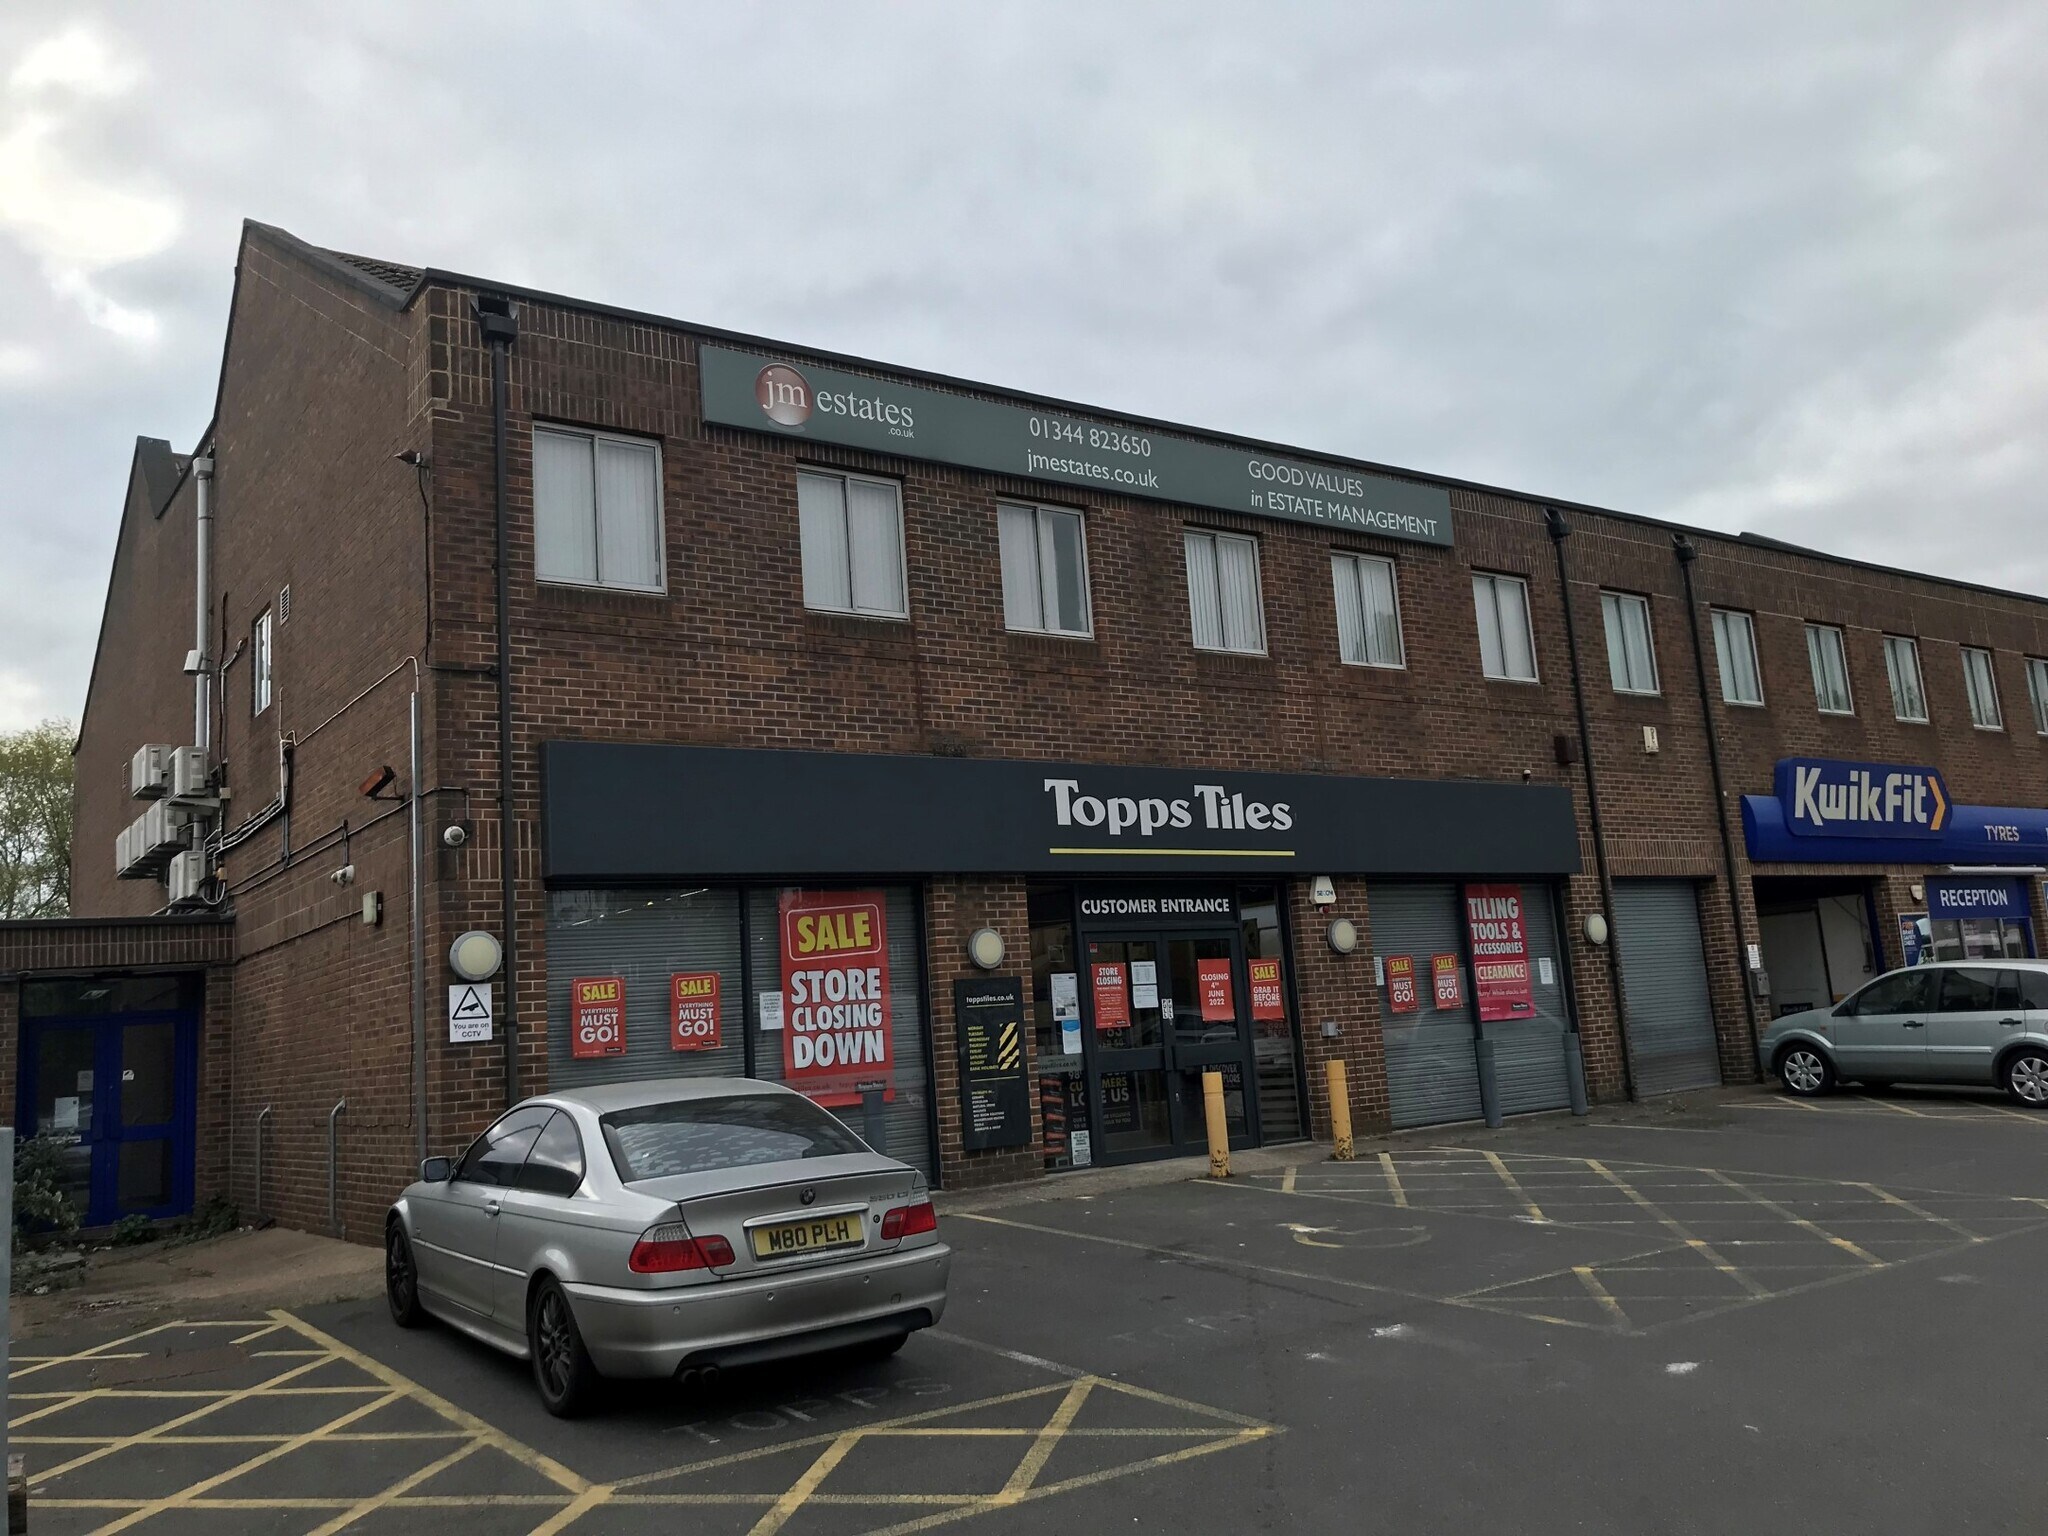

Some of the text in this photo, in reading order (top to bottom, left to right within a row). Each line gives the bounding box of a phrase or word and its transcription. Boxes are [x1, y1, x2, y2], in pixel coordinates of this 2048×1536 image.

[762, 371, 914, 428] jm estates
[888, 427, 914, 438] .co.uk
[1029, 416, 1151, 457] 01344 823650
[1027, 448, 1160, 488] jmestates.co.uk
[1248, 460, 1364, 498] GOOD VALUES
[1251, 490, 1437, 537] in ESTATE MANAGEMENT
[1044, 778, 1293, 836] Topps Tiles
[1984, 825, 2020, 842] TYRES
[1939, 888, 2009, 907] RECEPTION
[1081, 898, 1230, 914] CUSTOMER ENTRANCE
[1468, 896, 1519, 920] TILING
[797, 912, 872, 953] SALE
[1470, 922, 1522, 940] TOOLS &
[1474, 942, 1524, 955] ACCESSORIES
[1098, 967, 1118, 976] STORE
[1392, 960, 1409, 972] SALE
[1436, 958, 1453, 970] SALE
[1200, 972, 1228, 981] CLOSING
[1253, 966, 1276, 980] SALE
[1478, 964, 1525, 980] CLEARANCE
[680, 979, 711, 996] SALE
[790, 968, 882, 1005] STORE
[1096, 976, 1122, 986] CLOSING
[1393, 981, 1412, 990] MUST
[1438, 978, 1456, 988] MUST
[582, 984, 616, 1002] SALE
[1208, 990, 1224, 998] JUNE
[1254, 986, 1272, 994] GRAB
[1254, 993, 1280, 1001] BEFORE
[1394, 990, 1414, 1002] GO!
[1438, 986, 1458, 1000] GO!
[966, 993, 1014, 1004] toppstiles.co.uk
[1208, 998, 1225, 1006] 2022
[580, 1006, 618, 1014] EVERYTHING
[679, 1008, 714, 1020] MUST
[792, 1002, 883, 1032] CLOSING
[580, 1014, 618, 1027] MUST
[678, 1019, 714, 1037] GO!
[462, 1030, 482, 1038] CCTV
[580, 1025, 618, 1044] GO!
[793, 1030, 885, 1069] DOWN
[768, 1220, 850, 1252] M80 PLH
